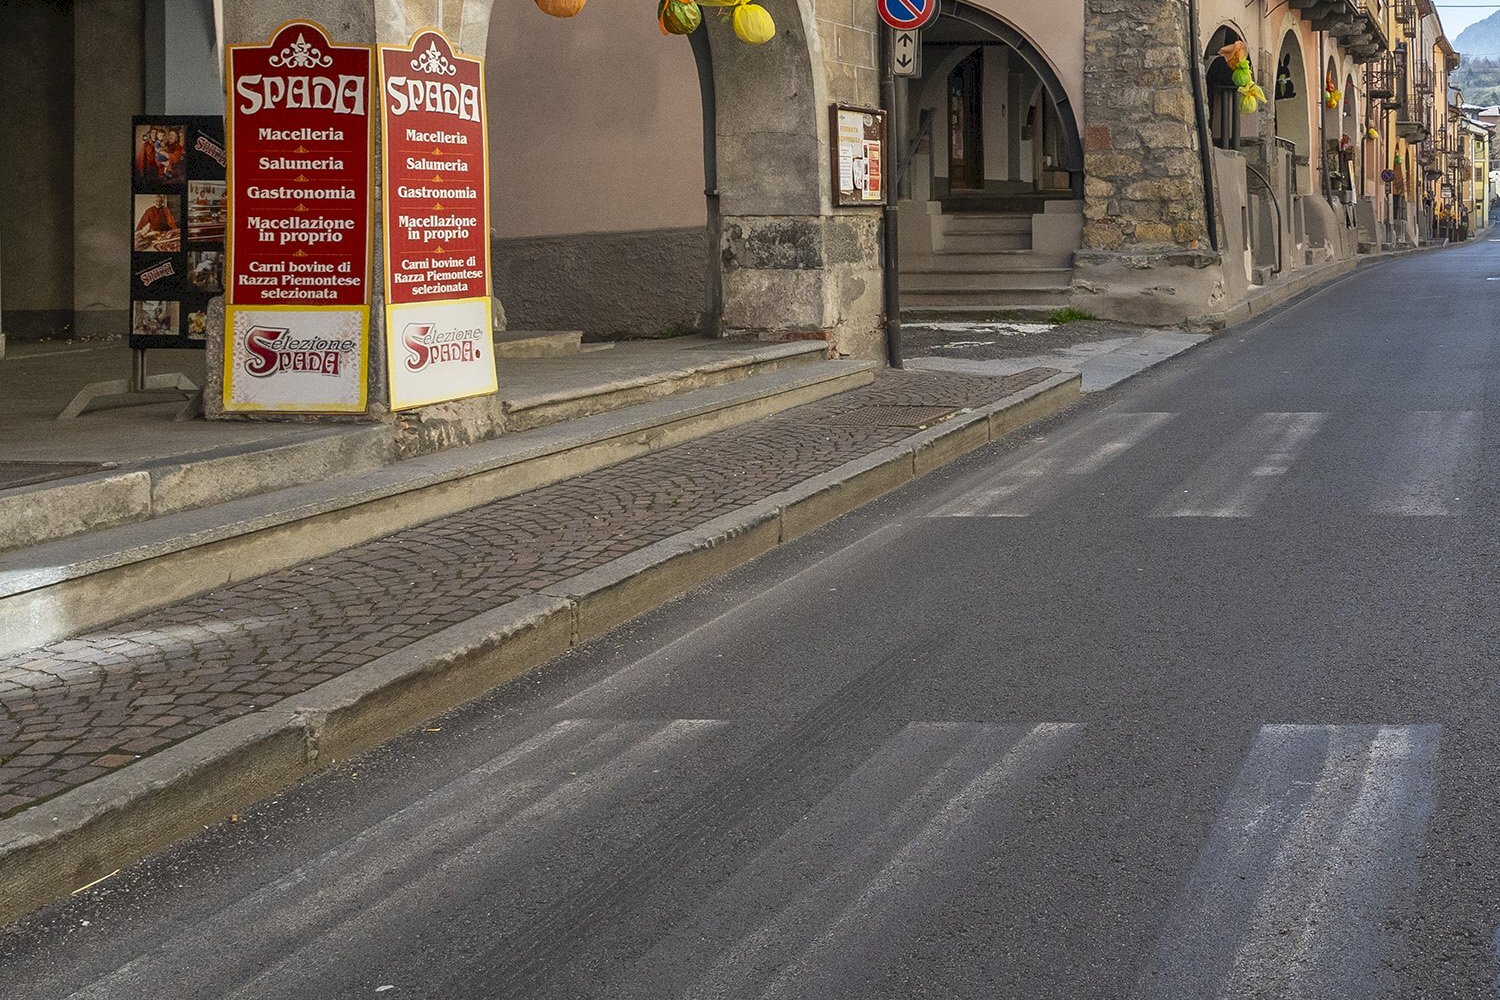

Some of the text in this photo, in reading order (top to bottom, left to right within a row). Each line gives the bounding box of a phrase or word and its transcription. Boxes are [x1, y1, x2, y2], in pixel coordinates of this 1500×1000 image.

[237, 74, 365, 115] SPADA
[387, 76, 480, 123] SPADA
[259, 127, 344, 140] Macelleria
[406, 129, 468, 144] Macelleria
[259, 157, 344, 170] Salumeria
[406, 158, 468, 172] Salumeria
[247, 186, 356, 199] Gastronomia
[397, 186, 477, 199] Gastronomia
[247, 216, 355, 229] Macellazione
[398, 215, 477, 227] Macellazione
[258, 229, 343, 245] in proprio
[407, 227, 469, 242] in proprio
[249, 261, 351, 273] Carni bovine di
[401, 256, 476, 270] Carni bovine di
[141, 262, 175, 286] SPADA
[239, 274, 361, 286] Razza Piemontese
[394, 269, 483, 283] Razza Piemontese
[261, 287, 337, 299] selezionata
[412, 282, 468, 295] selezionata
[244, 325, 356, 377] Selezione
[402, 323, 482, 373] Selezione
